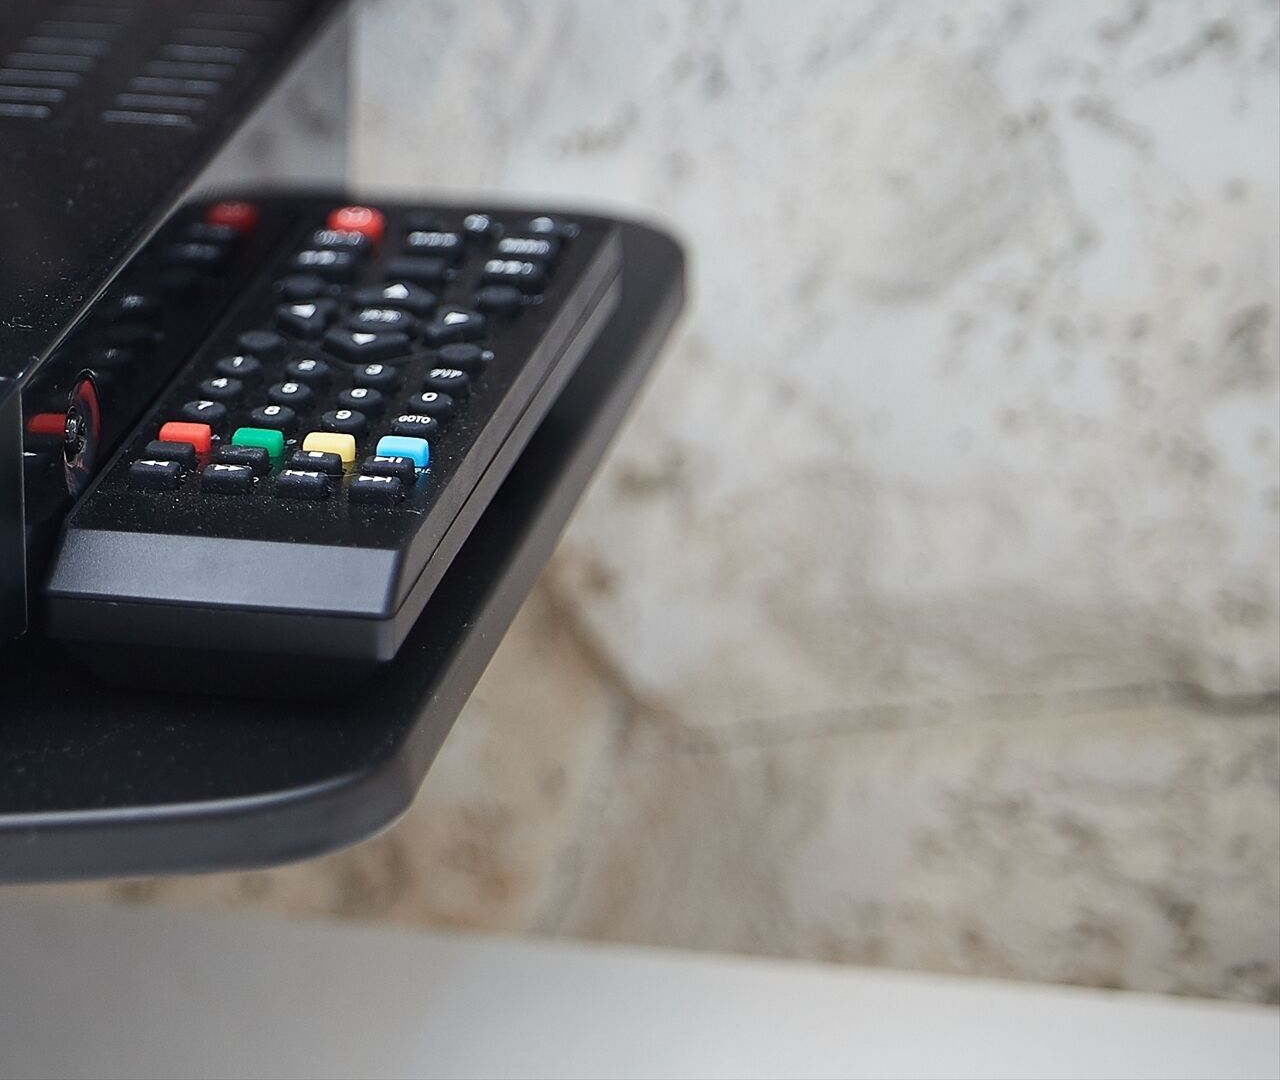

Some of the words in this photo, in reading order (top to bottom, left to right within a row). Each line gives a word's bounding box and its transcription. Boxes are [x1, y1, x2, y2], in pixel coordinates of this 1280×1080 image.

[197, 401, 214, 411] 7
[335, 409, 352, 420] 9
[398, 415, 431, 425] GOTO
